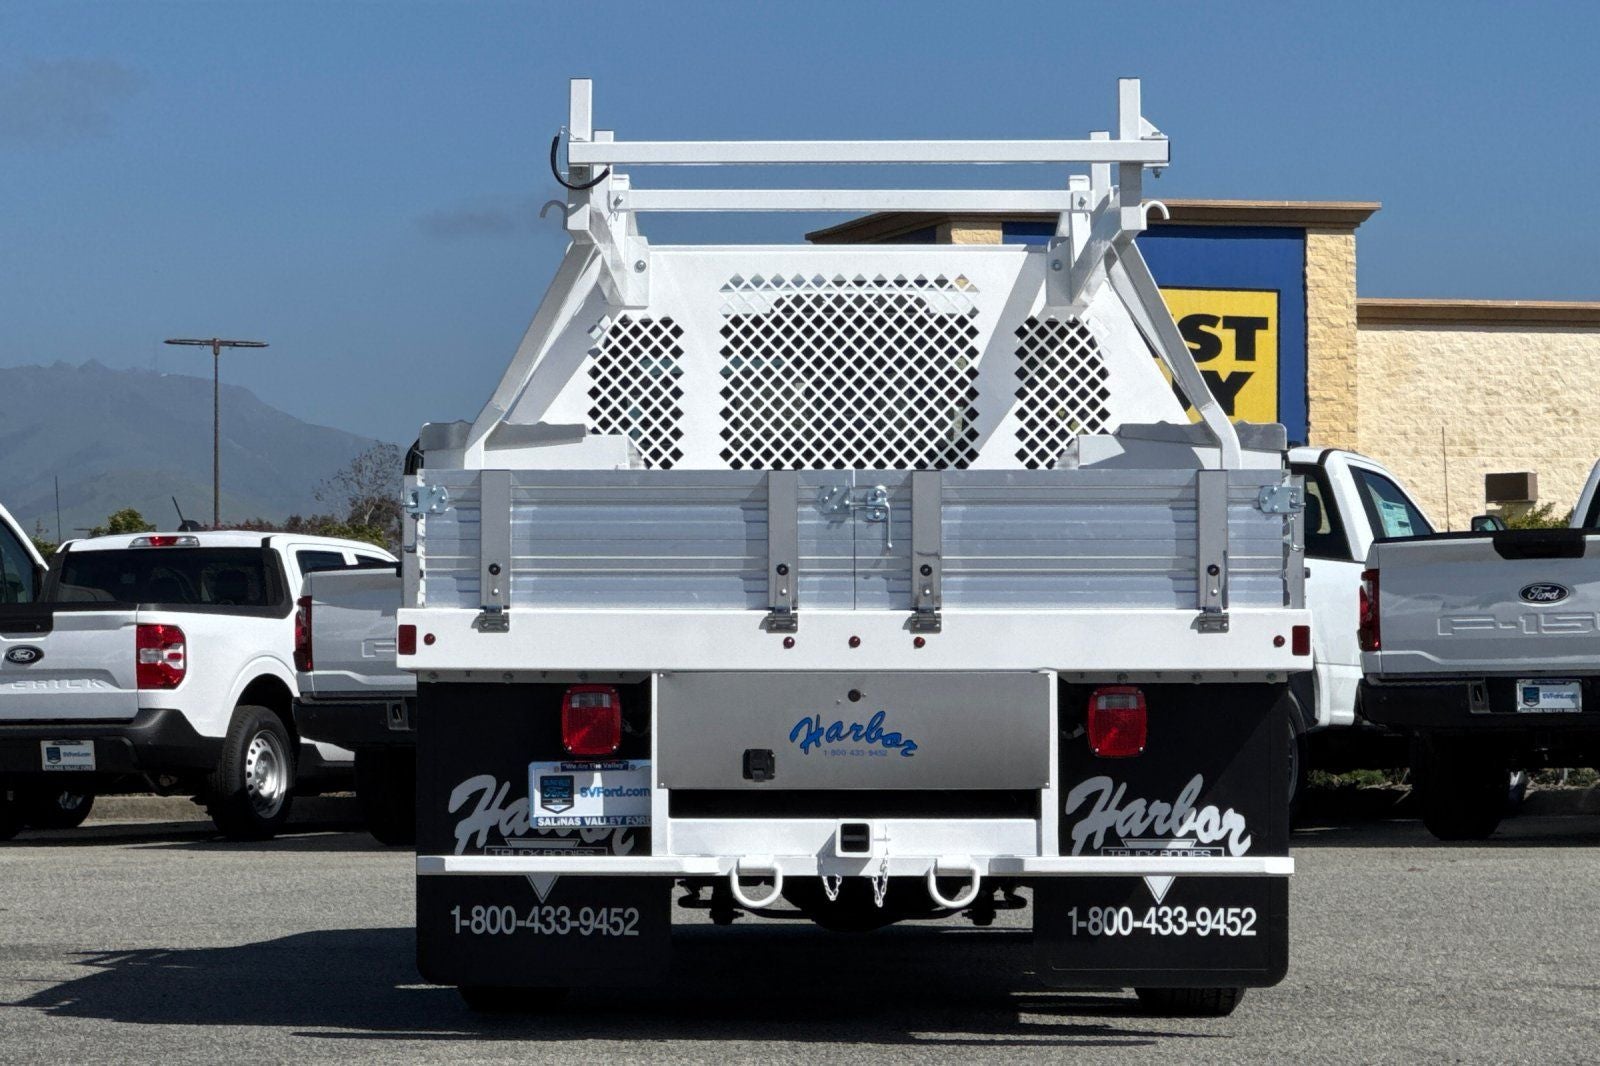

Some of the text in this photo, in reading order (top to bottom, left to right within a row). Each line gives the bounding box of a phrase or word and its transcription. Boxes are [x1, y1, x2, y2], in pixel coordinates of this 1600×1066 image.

[1134, 313, 1269, 364] ST
[1527, 586, 1560, 600] Ford
[1437, 611, 1600, 636] F-15
[789, 710, 918, 757] Harbor
[580, 786, 651, 798] SVFord.com
[537, 817, 581, 826] SALINAS
[585, 817, 623, 826] VALLEY
[1065, 773, 1252, 857] Harbor
[450, 904, 639, 936] 1-800-433-9452
[1067, 906, 1258, 937] 1-800-433-9452
